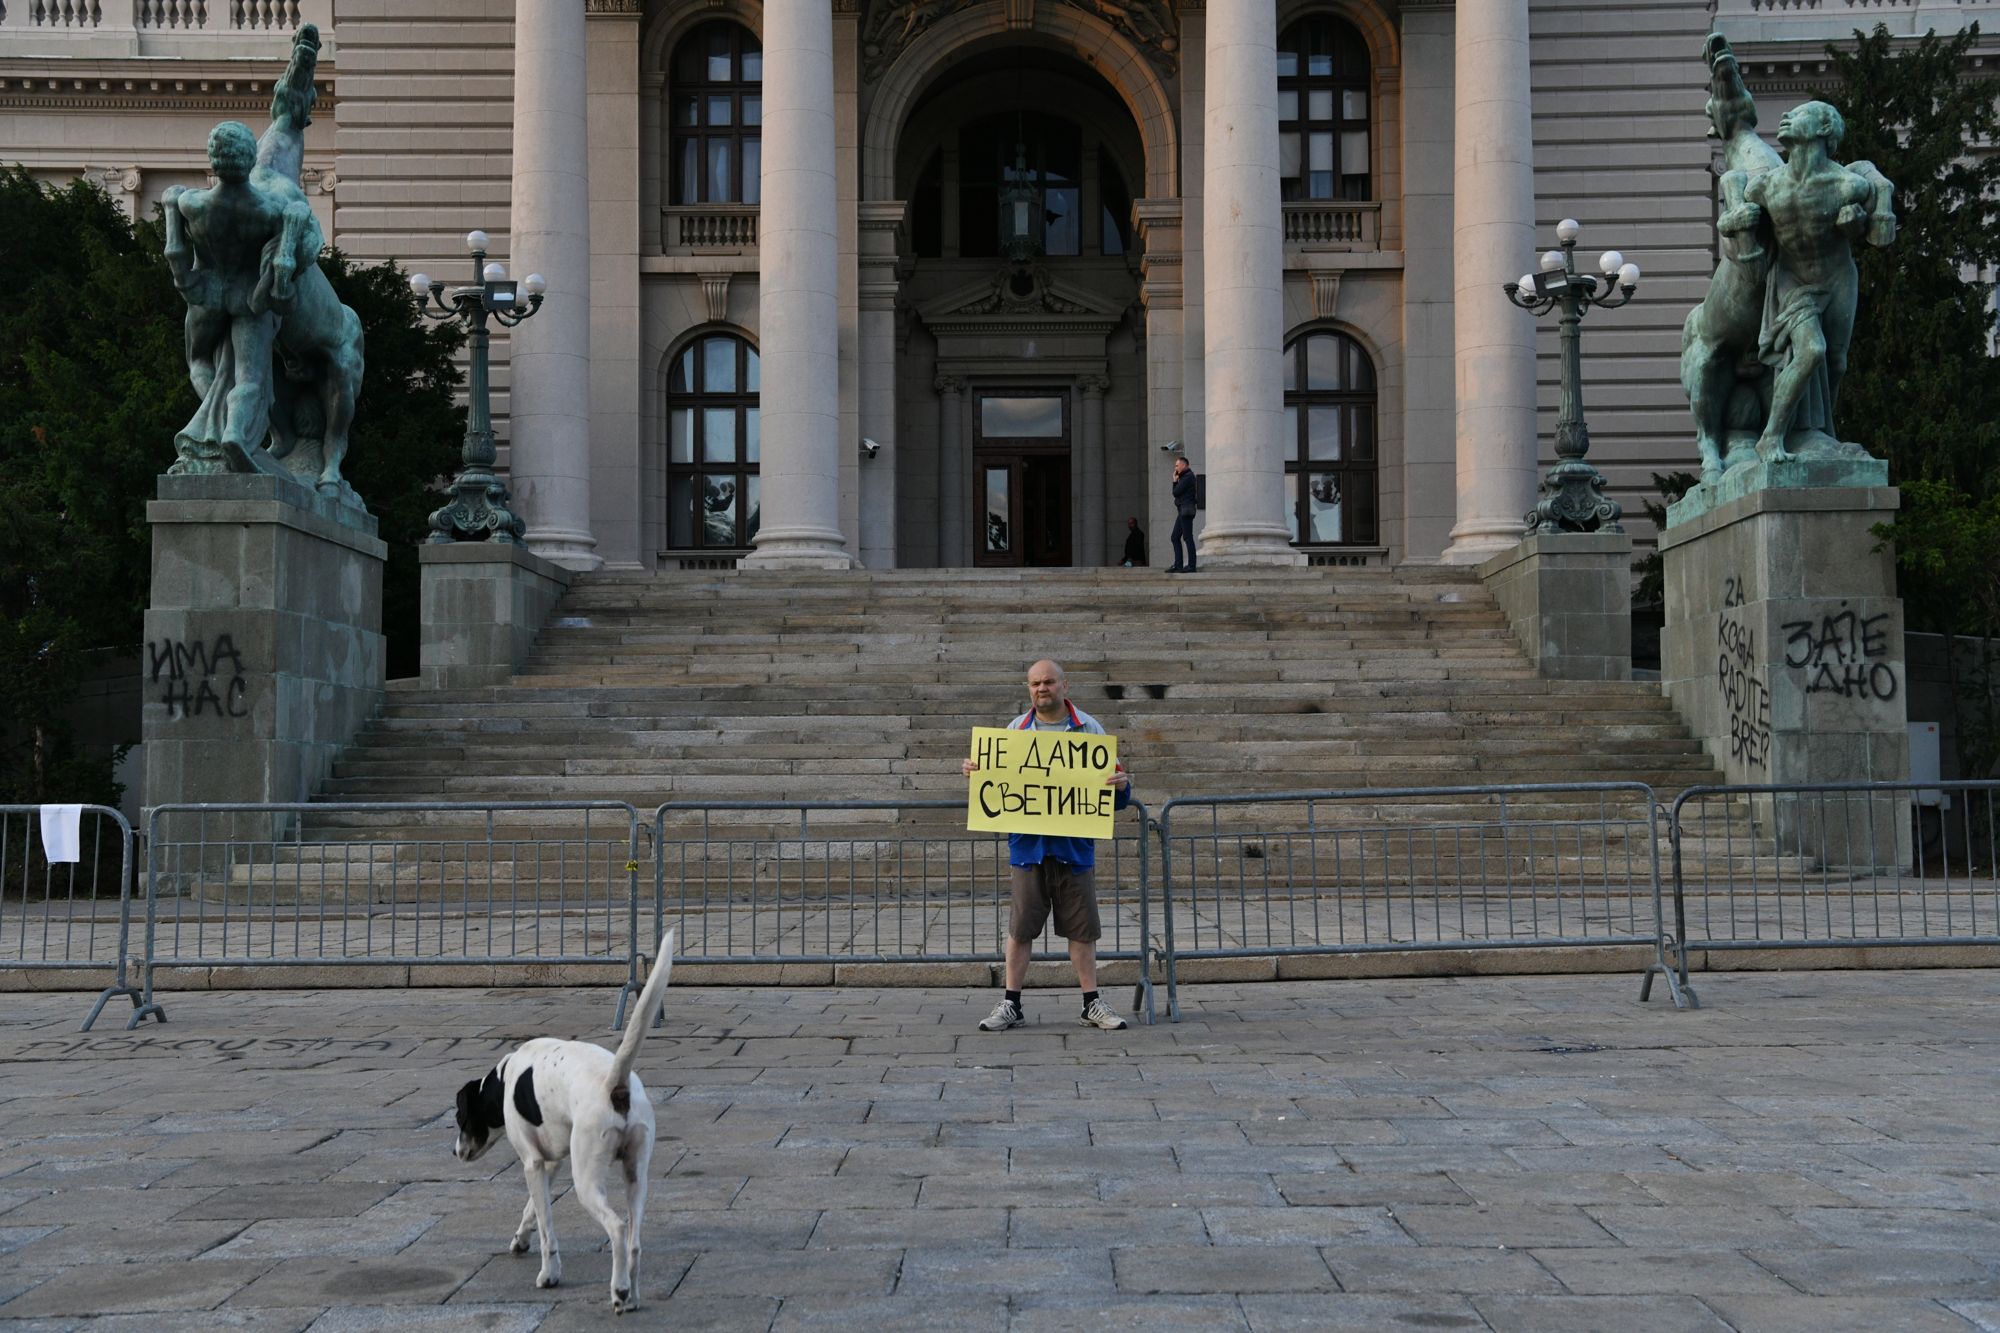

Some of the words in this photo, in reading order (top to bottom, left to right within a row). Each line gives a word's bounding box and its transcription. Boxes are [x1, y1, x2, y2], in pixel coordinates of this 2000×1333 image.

[148, 633, 245, 683] ИМА
[1718, 611, 1755, 673] KOGA
[161, 675, 248, 718] НАС
[1719, 654, 1771, 731] RADITE
[1806, 662, 1897, 702] ДНО
[977, 737, 1008, 770] НЕ
[1019, 737, 1109, 777] ДАМО
[979, 780, 1112, 818] СВЕТИЊЕ
